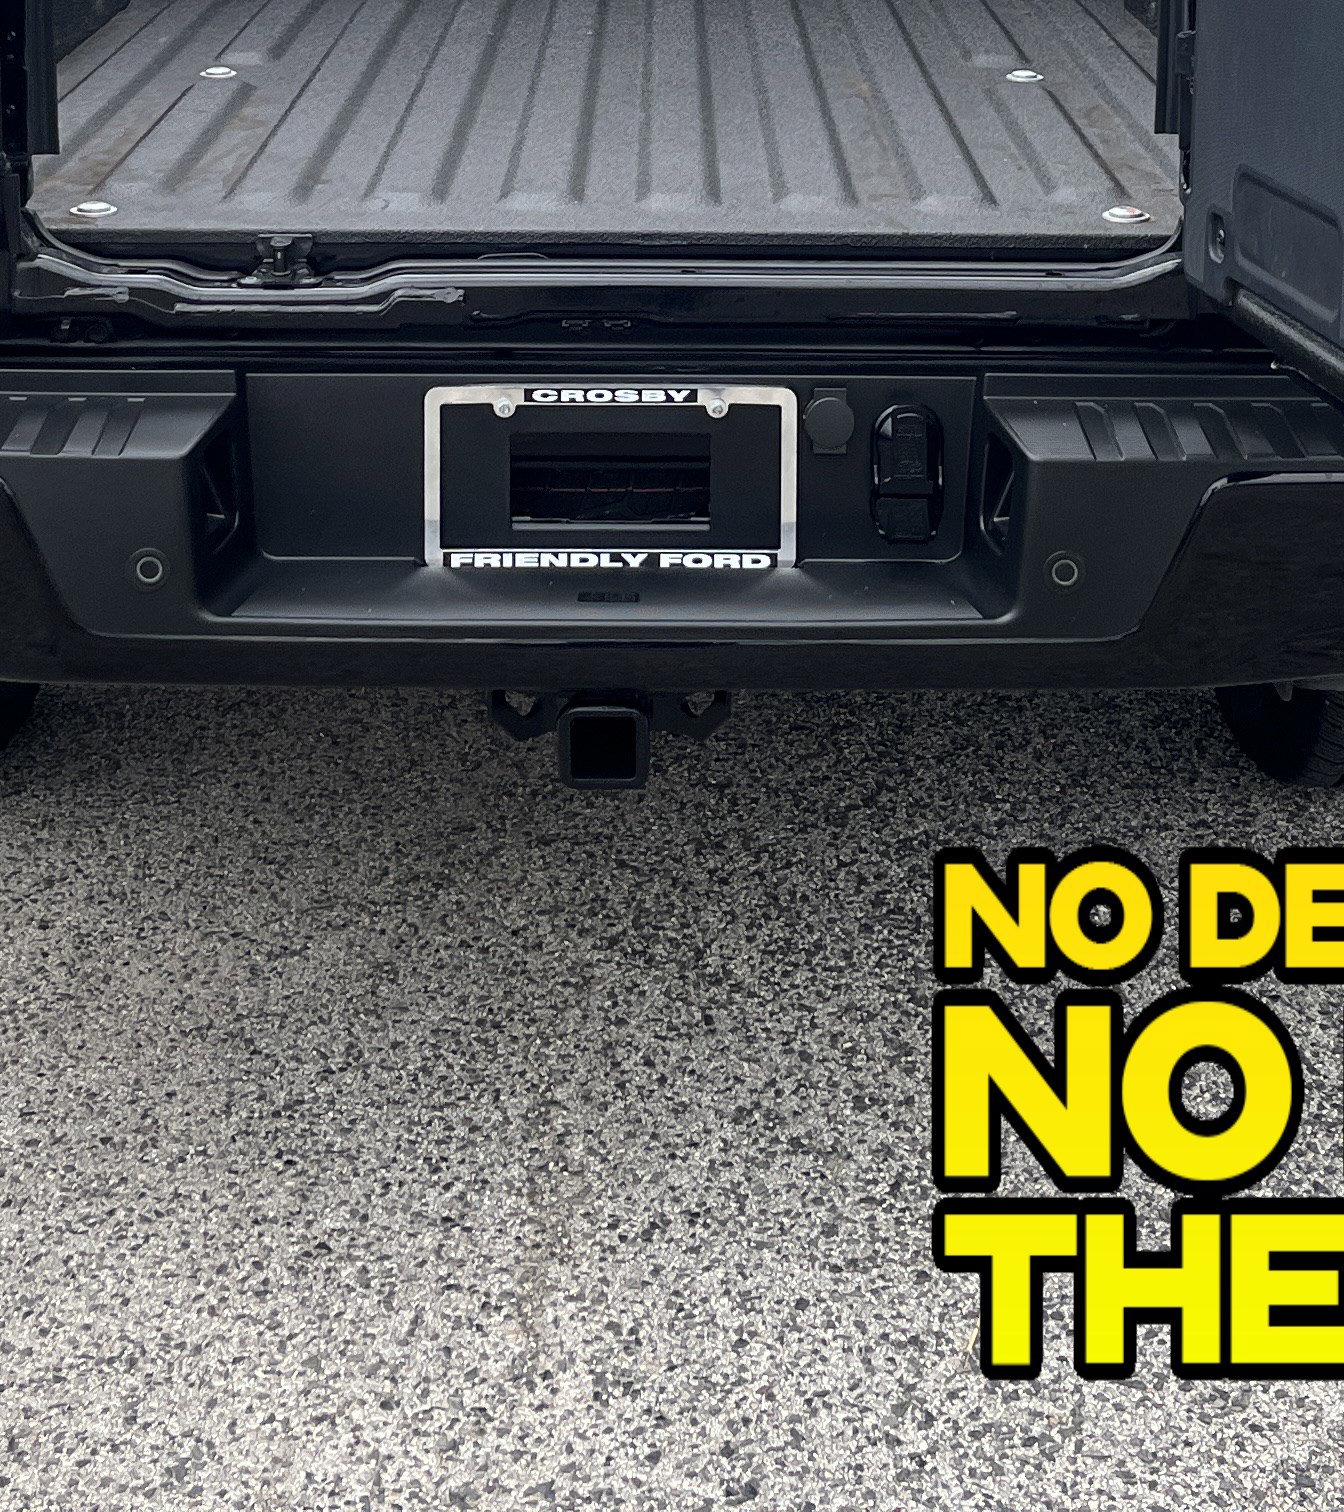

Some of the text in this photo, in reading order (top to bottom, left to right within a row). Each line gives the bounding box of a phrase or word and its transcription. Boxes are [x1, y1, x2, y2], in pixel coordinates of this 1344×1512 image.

[531, 388, 692, 403] CROSBY
[450, 552, 772, 569] FRIENDLY FORD
